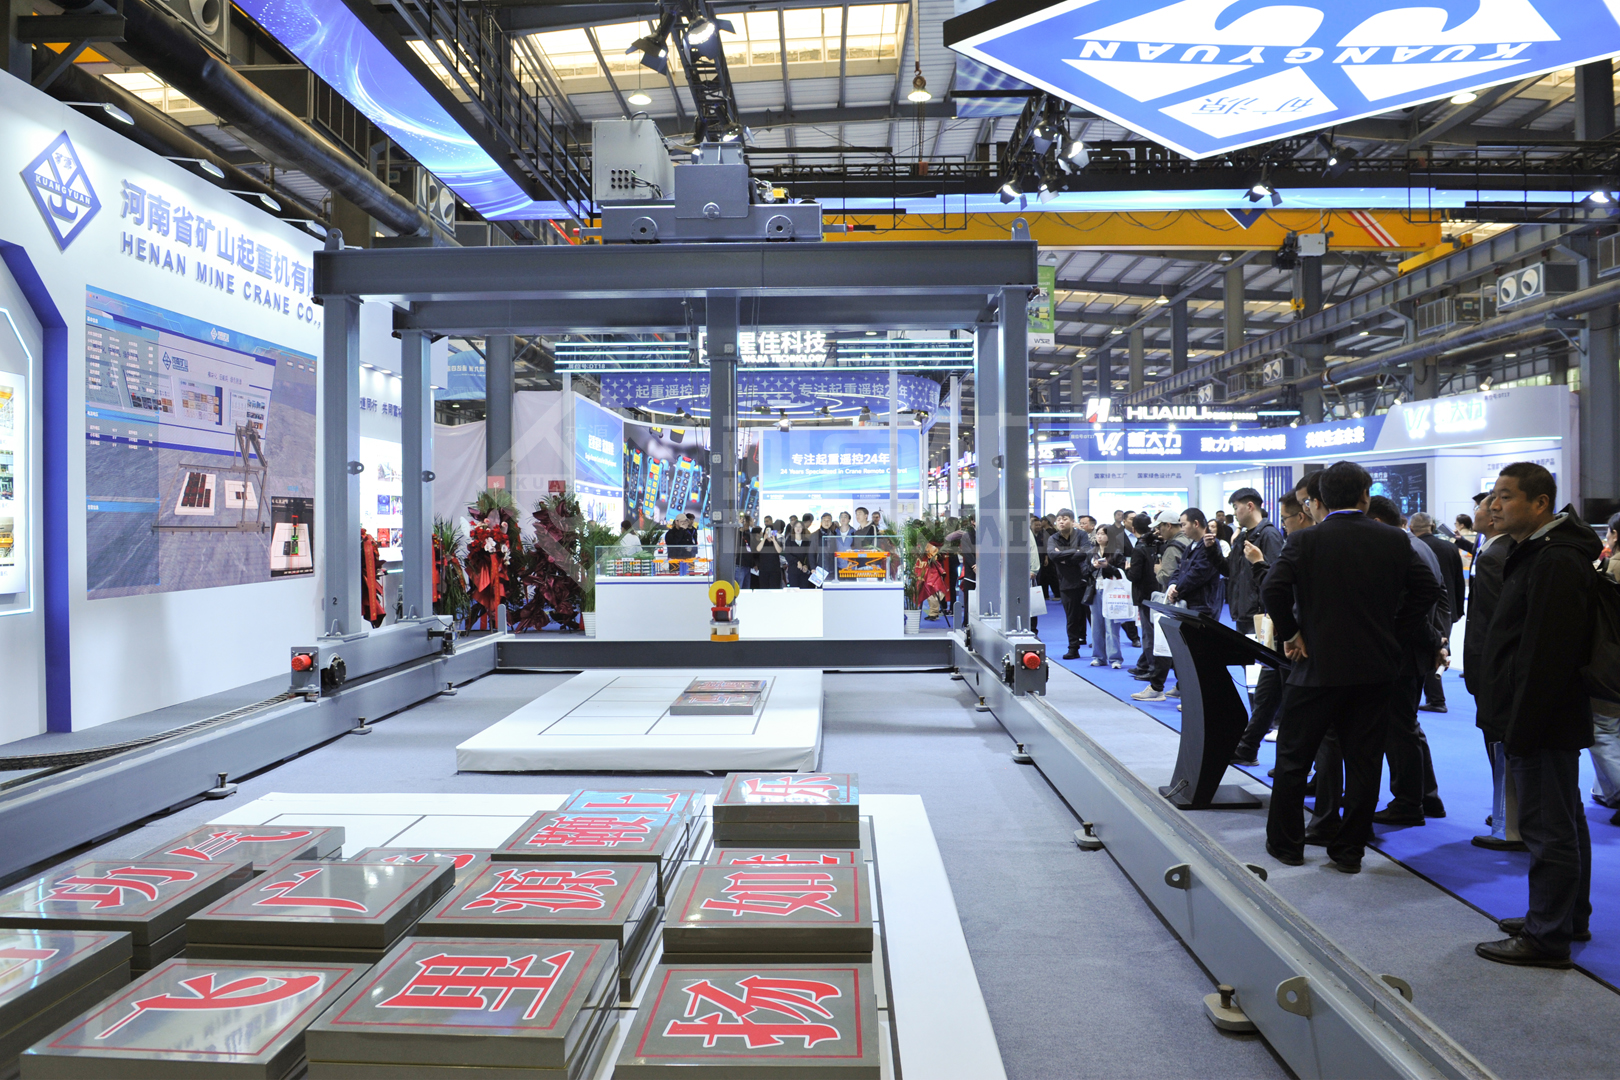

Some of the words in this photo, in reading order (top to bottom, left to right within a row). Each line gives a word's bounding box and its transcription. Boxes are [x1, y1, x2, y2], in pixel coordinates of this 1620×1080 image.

[1079, 40, 1532, 65] KUANGYUAN
[1192, 96, 1313, 115] 矿源
[35, 174, 91, 205] KUANGYUAN
[120, 231, 186, 275] HENAN
[196, 261, 235, 293] MINE
[243, 281, 290, 315] CRANE
[635, 384, 694, 399] 起重遥控
[798, 382, 908, 399] 专注起重遥控2年
[1127, 406, 1207, 420] HUAWU
[792, 452, 890, 466] 专注起重遥控24年
[745, 775, 840, 802] 乐
[164, 829, 312, 861] 气
[526, 815, 656, 847] 鞭
[33, 865, 198, 910] 功
[252, 867, 368, 914] 广
[461, 868, 617, 914] 源
[700, 871, 843, 918] 如
[375, 950, 574, 1020] 里
[94, 972, 326, 1040] 飞
[663, 974, 842, 1049] 扬
